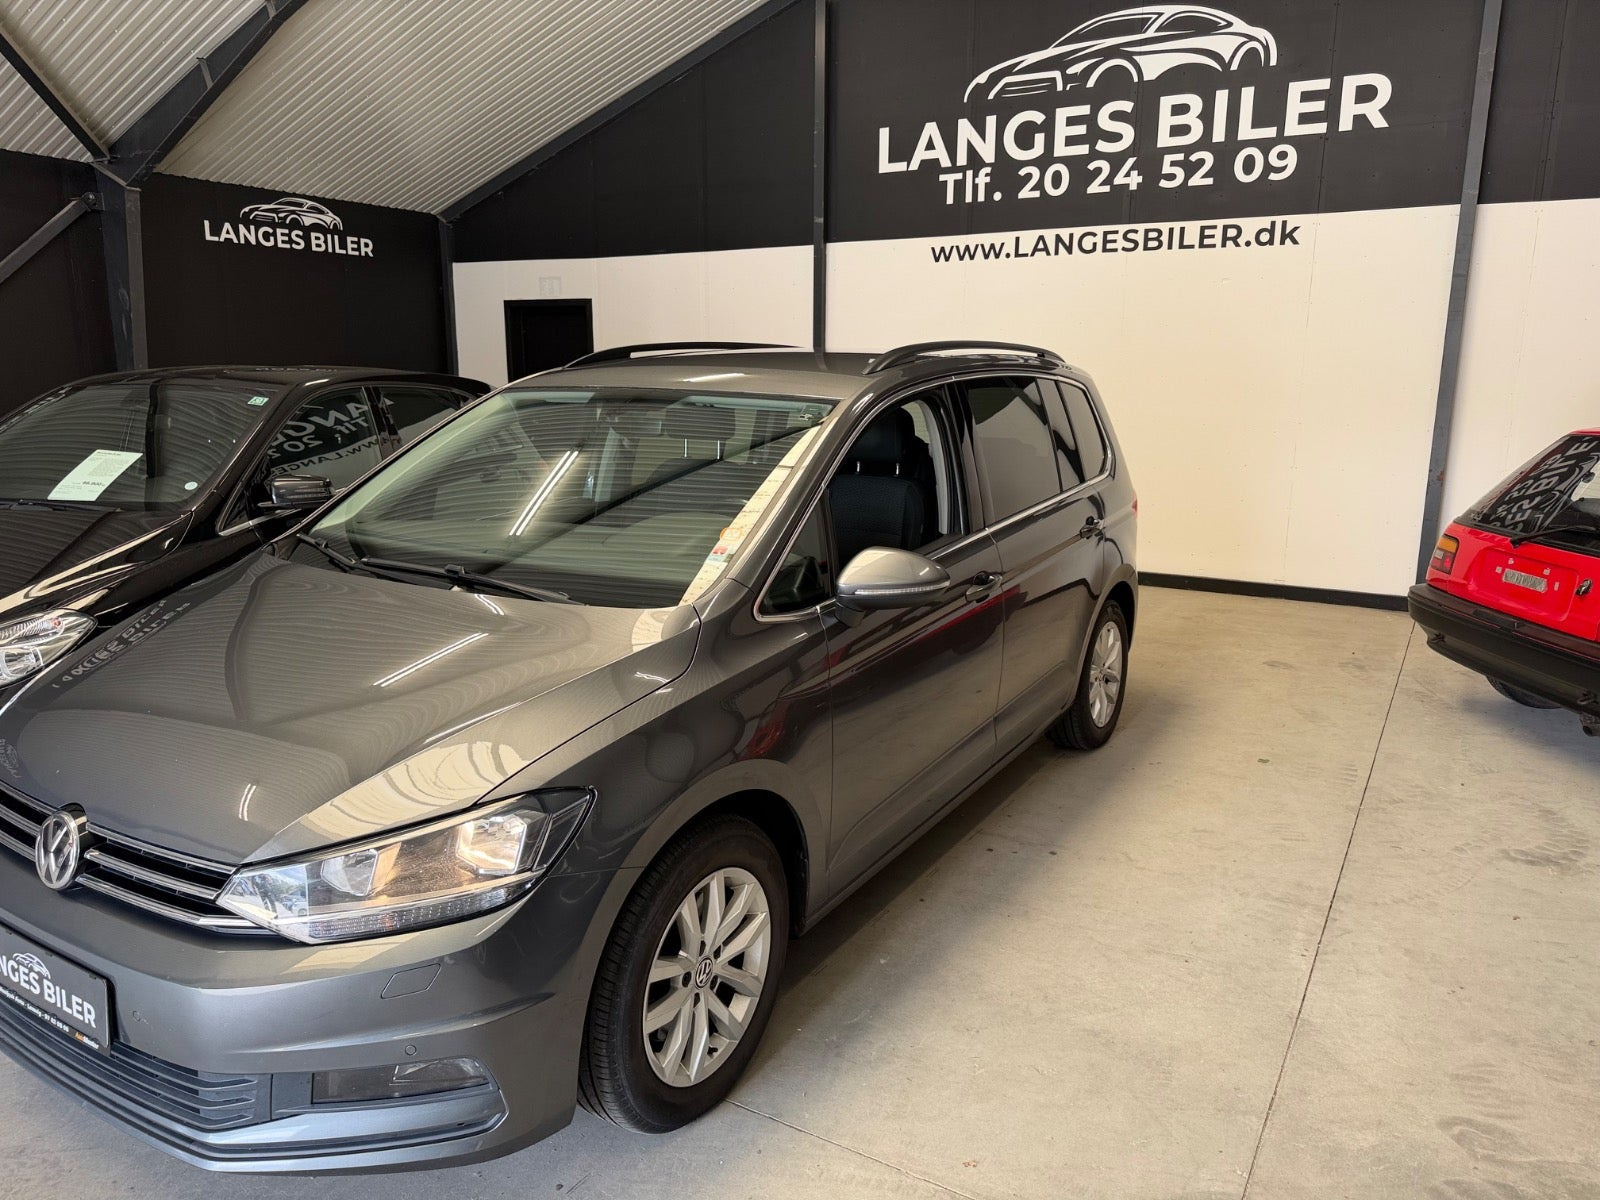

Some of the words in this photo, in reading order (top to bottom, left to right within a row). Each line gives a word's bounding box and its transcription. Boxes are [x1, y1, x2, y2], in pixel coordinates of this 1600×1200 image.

[878, 100, 1135, 174] LANGES
[1156, 73, 1393, 149] BILER
[938, 167, 1003, 205] Tlf.
[1017, 163, 1070, 200] 20
[1086, 157, 1143, 195] 24
[1158, 151, 1215, 189] 52
[1233, 144, 1298, 183] 09
[203, 219, 306, 250] LANGES
[310, 231, 374, 258] BILER
[931, 220, 1301, 263] www.LANGESBILER.dk
[43, 978, 97, 1029] BILER
